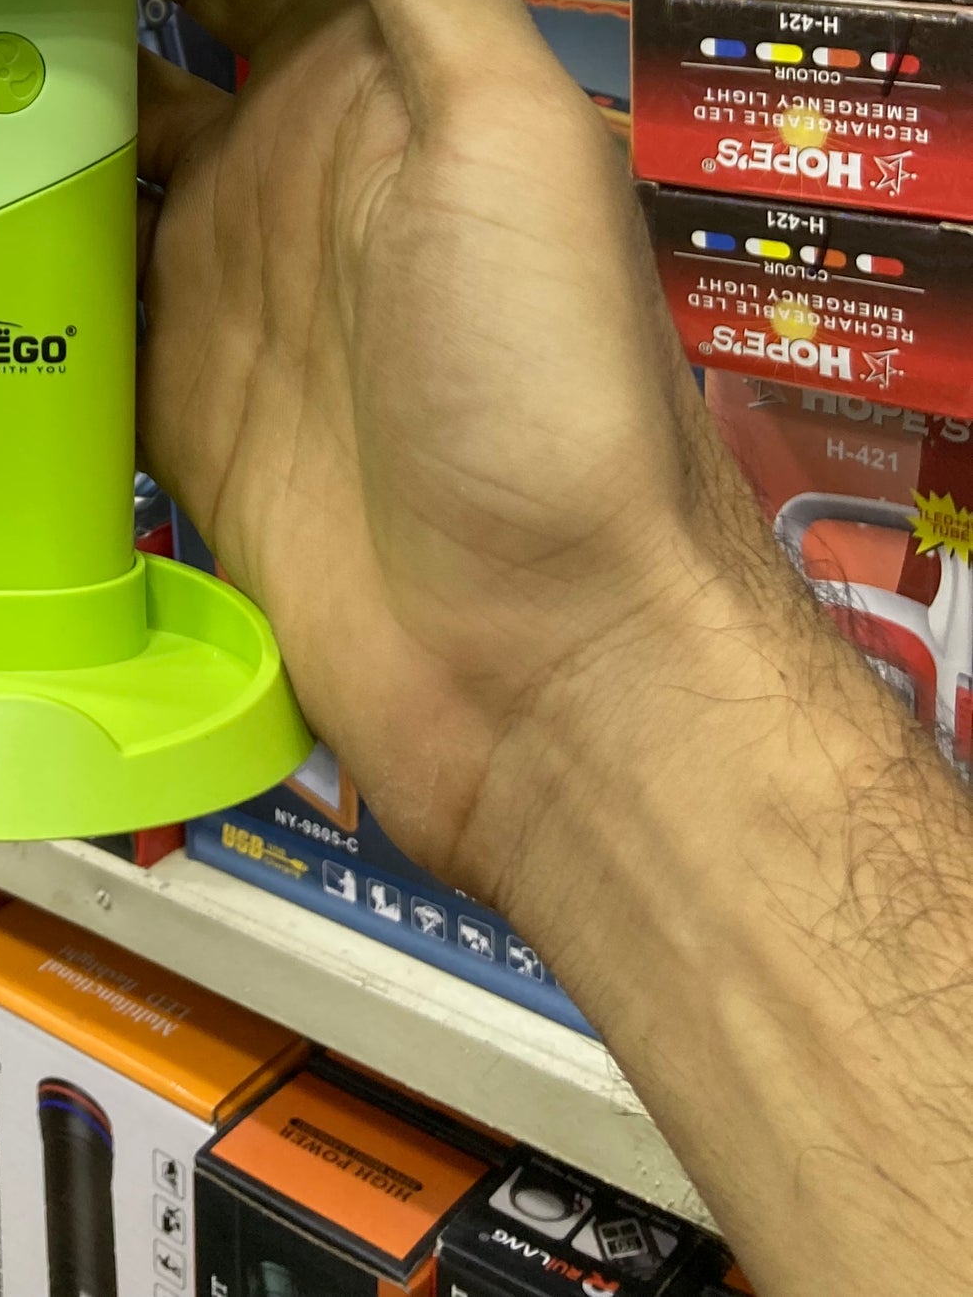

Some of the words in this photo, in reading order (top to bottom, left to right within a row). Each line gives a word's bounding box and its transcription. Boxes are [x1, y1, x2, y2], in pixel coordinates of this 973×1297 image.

[778, 12, 839, 35] H-421
[773, 65, 842, 86] COLOUR
[702, 86, 768, 106] LIGHT
[776, 93, 919, 123] EMERGENCY
[692, 104, 735, 123] LED
[743, 108, 929, 144] RECHARGEABLE
[765, 209, 825, 235] H-421
[763, 260, 829, 283] COLOUR
[694, 275, 758, 297] LIGHT
[686, 291, 727, 310] LED
[766, 286, 904, 324] EMERGENCY
[735, 299, 915, 345] RECHARGEABLE
[36, 365, 67, 375] YOU
[825, 438, 901, 473] H-421
[220, 821, 266, 860] USB
[36, 958, 179, 1038] Multifunctional
[278, 1125, 352, 1172] POWER
[353, 1165, 414, 1203] HIGH
